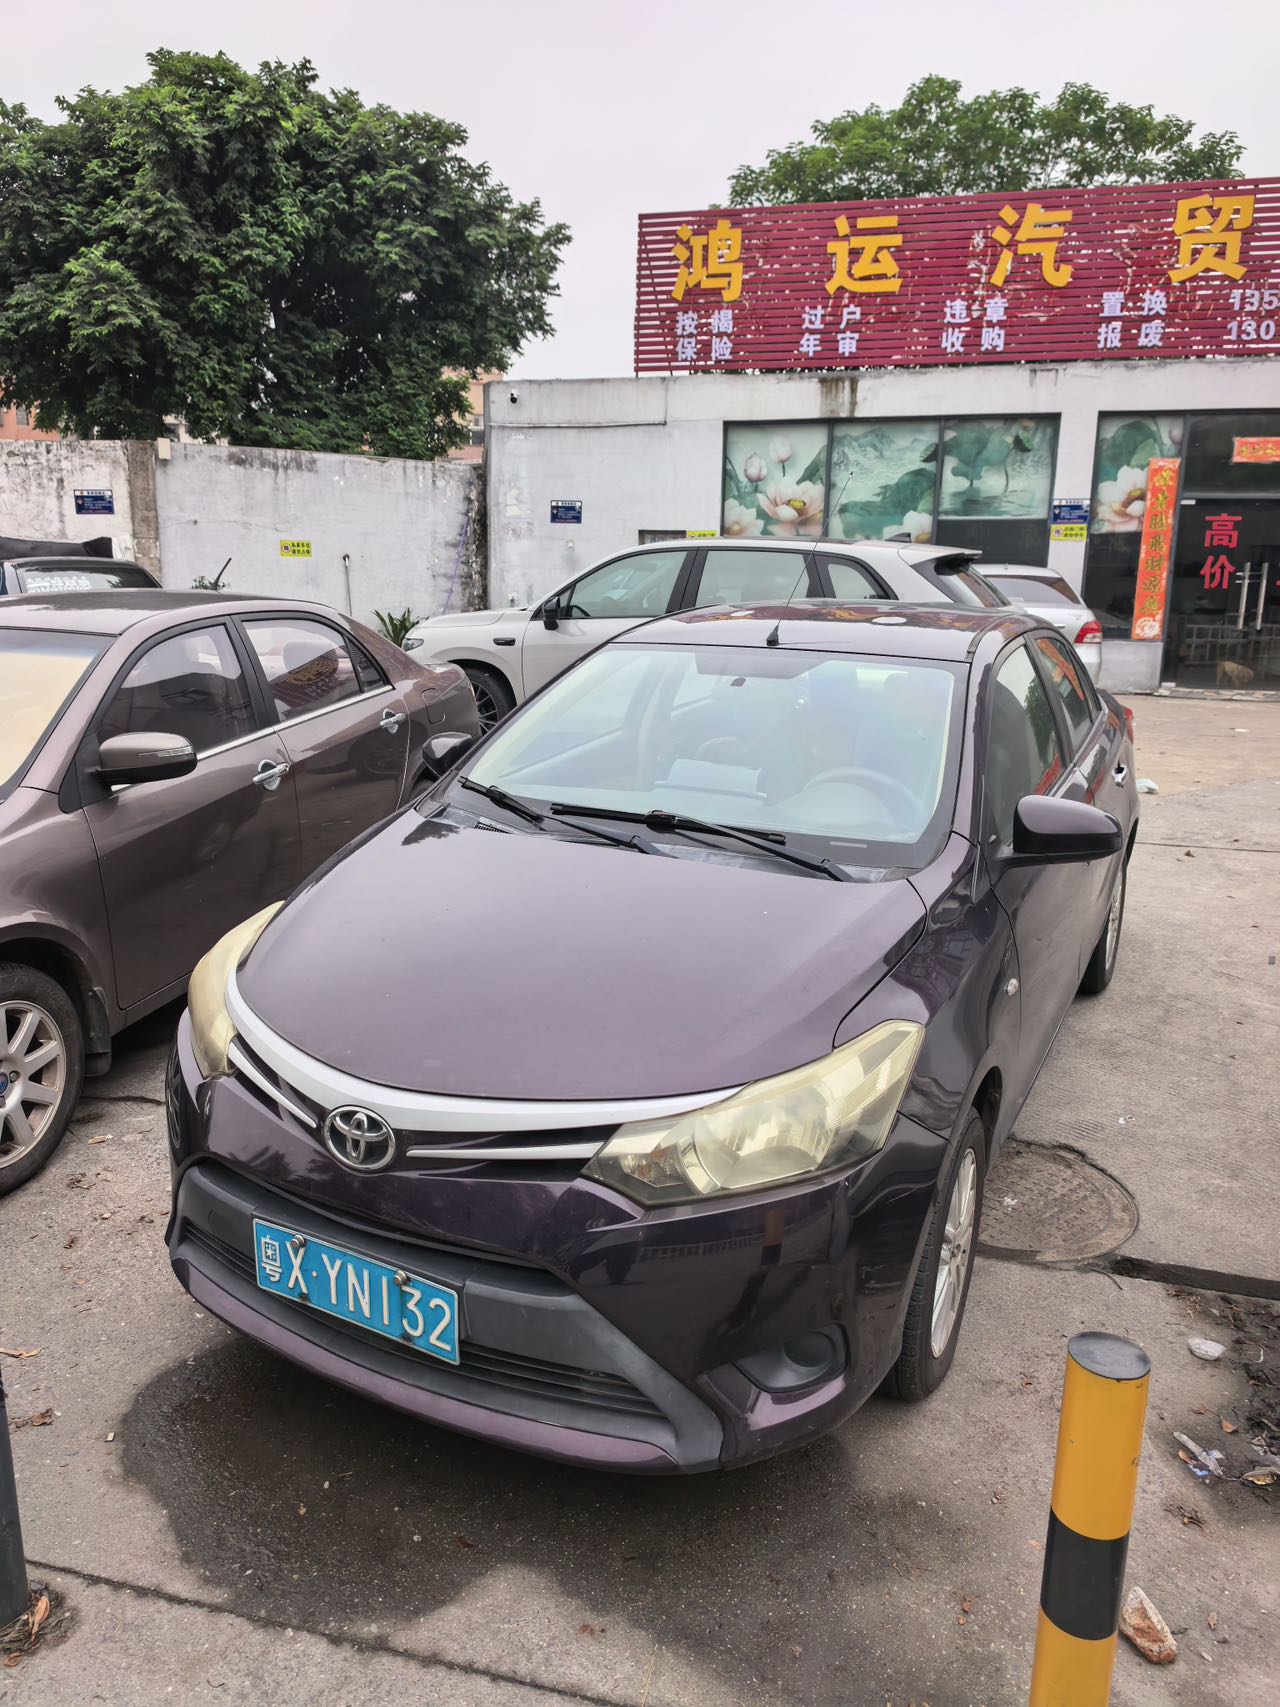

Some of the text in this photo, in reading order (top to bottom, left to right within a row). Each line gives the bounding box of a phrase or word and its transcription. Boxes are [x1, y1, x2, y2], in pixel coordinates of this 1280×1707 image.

[671, 193, 1255, 303] 鸿运汽贸
[675, 289, 1280, 335] 按揭 过户 违章 置换 135
[676, 336, 734, 361] 保险
[800, 332, 860, 357] 年审
[941, 326, 1006, 353] 收购
[1097, 320, 1166, 348] 报废
[1200, 513, 1243, 590] 高价
